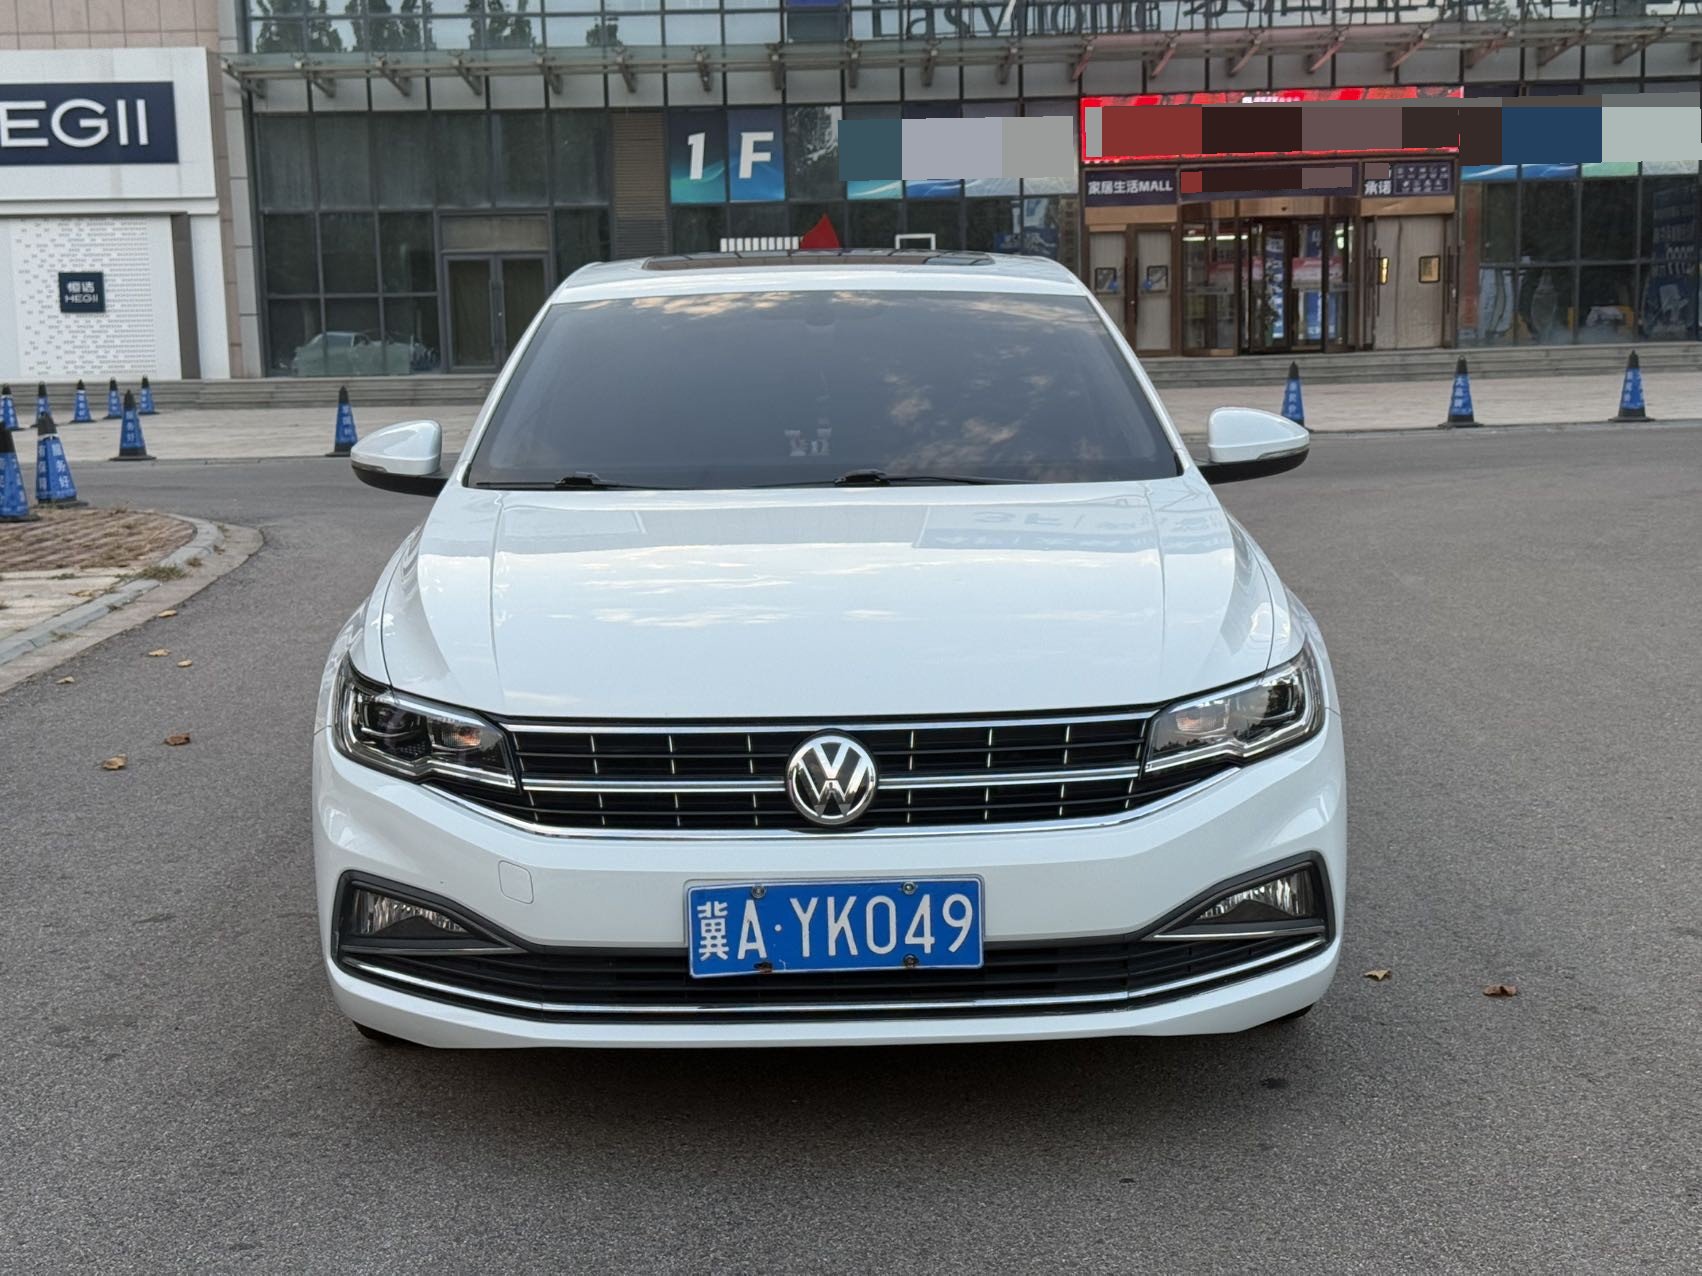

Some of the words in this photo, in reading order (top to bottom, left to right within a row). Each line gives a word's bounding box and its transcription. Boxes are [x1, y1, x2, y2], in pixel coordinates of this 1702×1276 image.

[1088, 179, 1174, 195] 家居生活MALL
[1365, 180, 1392, 195] 承诺
[697, 893, 973, 961] 冀A·YK049
